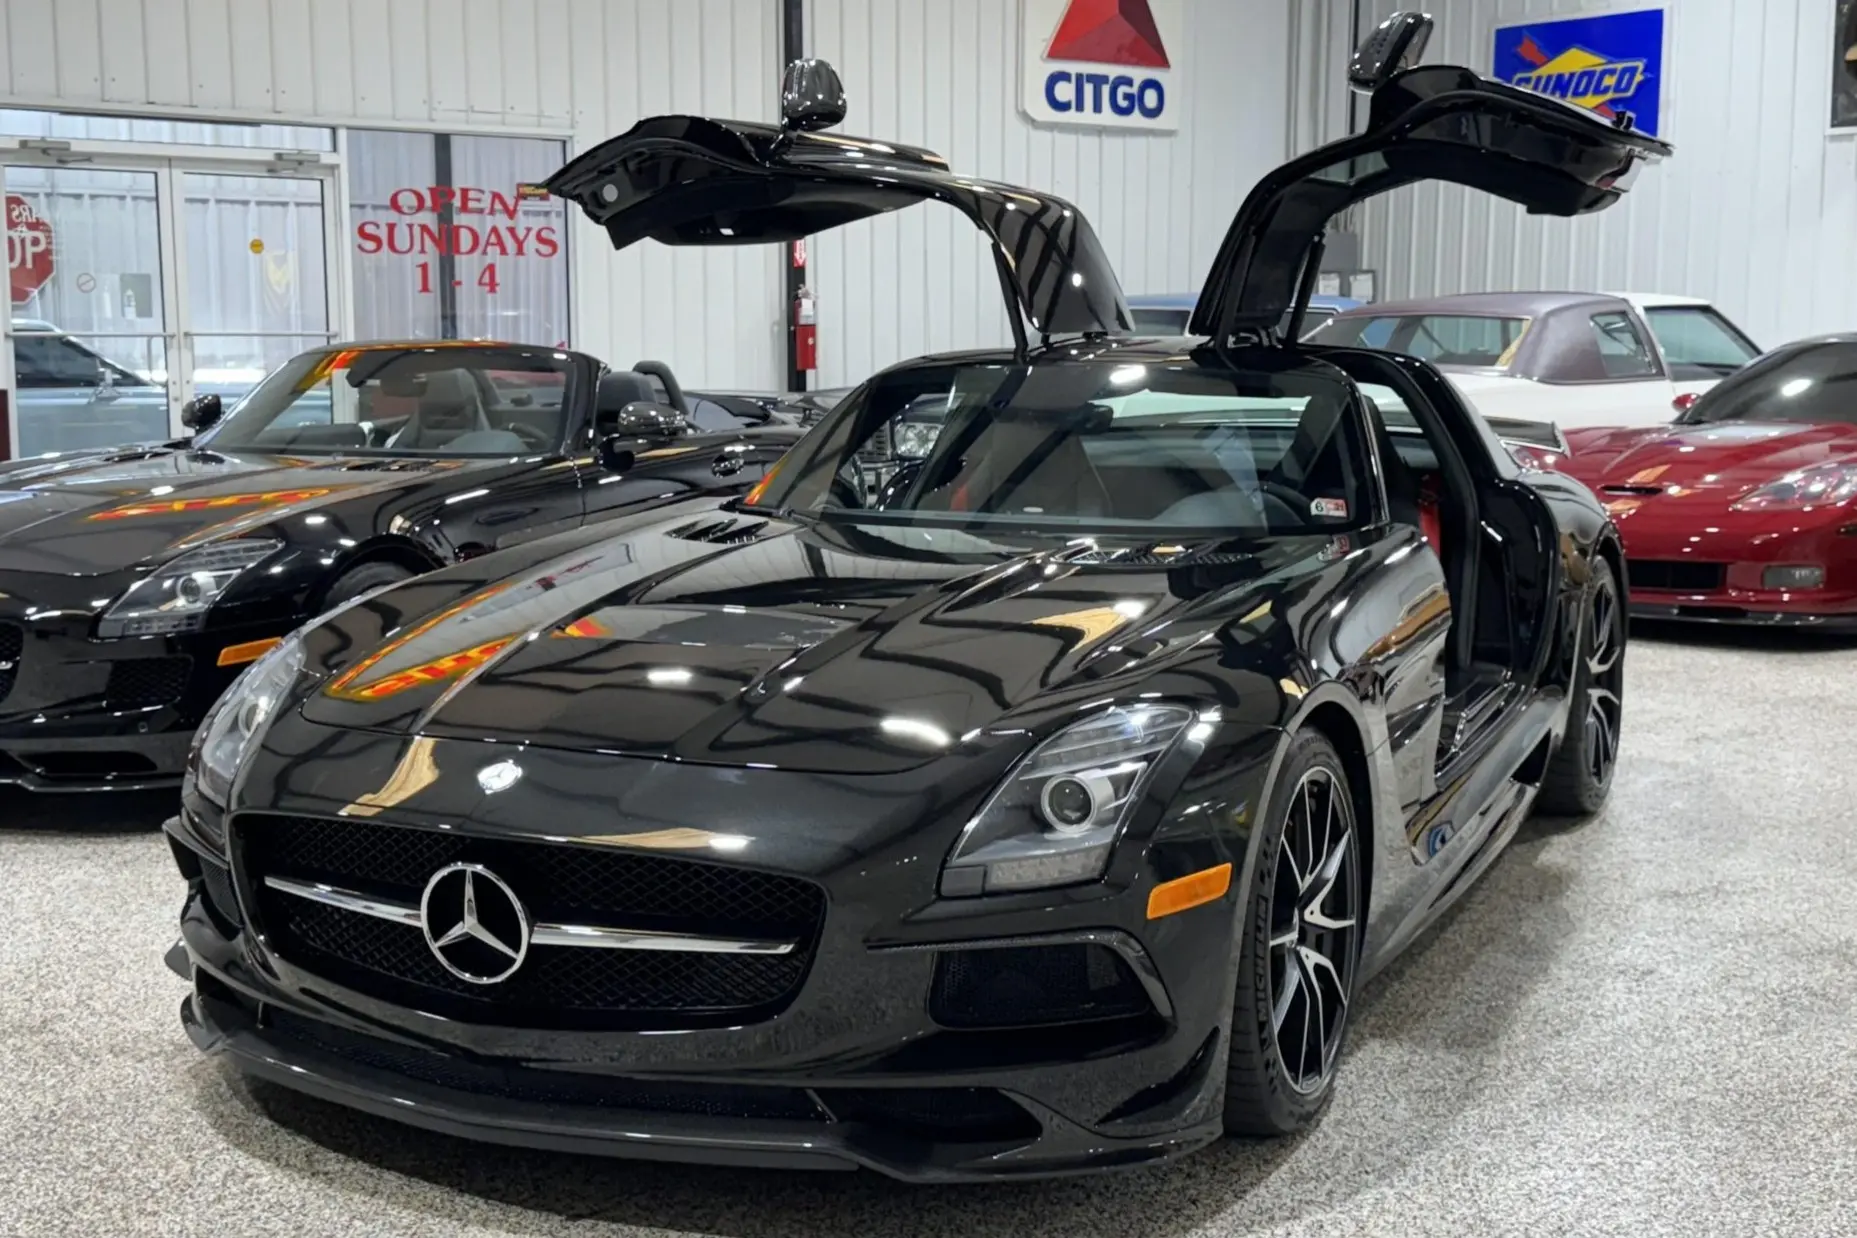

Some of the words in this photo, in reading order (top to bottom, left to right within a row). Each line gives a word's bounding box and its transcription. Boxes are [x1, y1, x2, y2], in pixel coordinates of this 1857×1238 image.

[1045, 70, 1165, 119] CITGO
[389, 186, 520, 221] OPEN
[8, 230, 47, 269] OP
[357, 221, 559, 258] SUNDAYS
[416, 261, 433, 294] 1
[477, 262, 500, 295] 4
[1255, 895, 1269, 1022] MICHELIN
